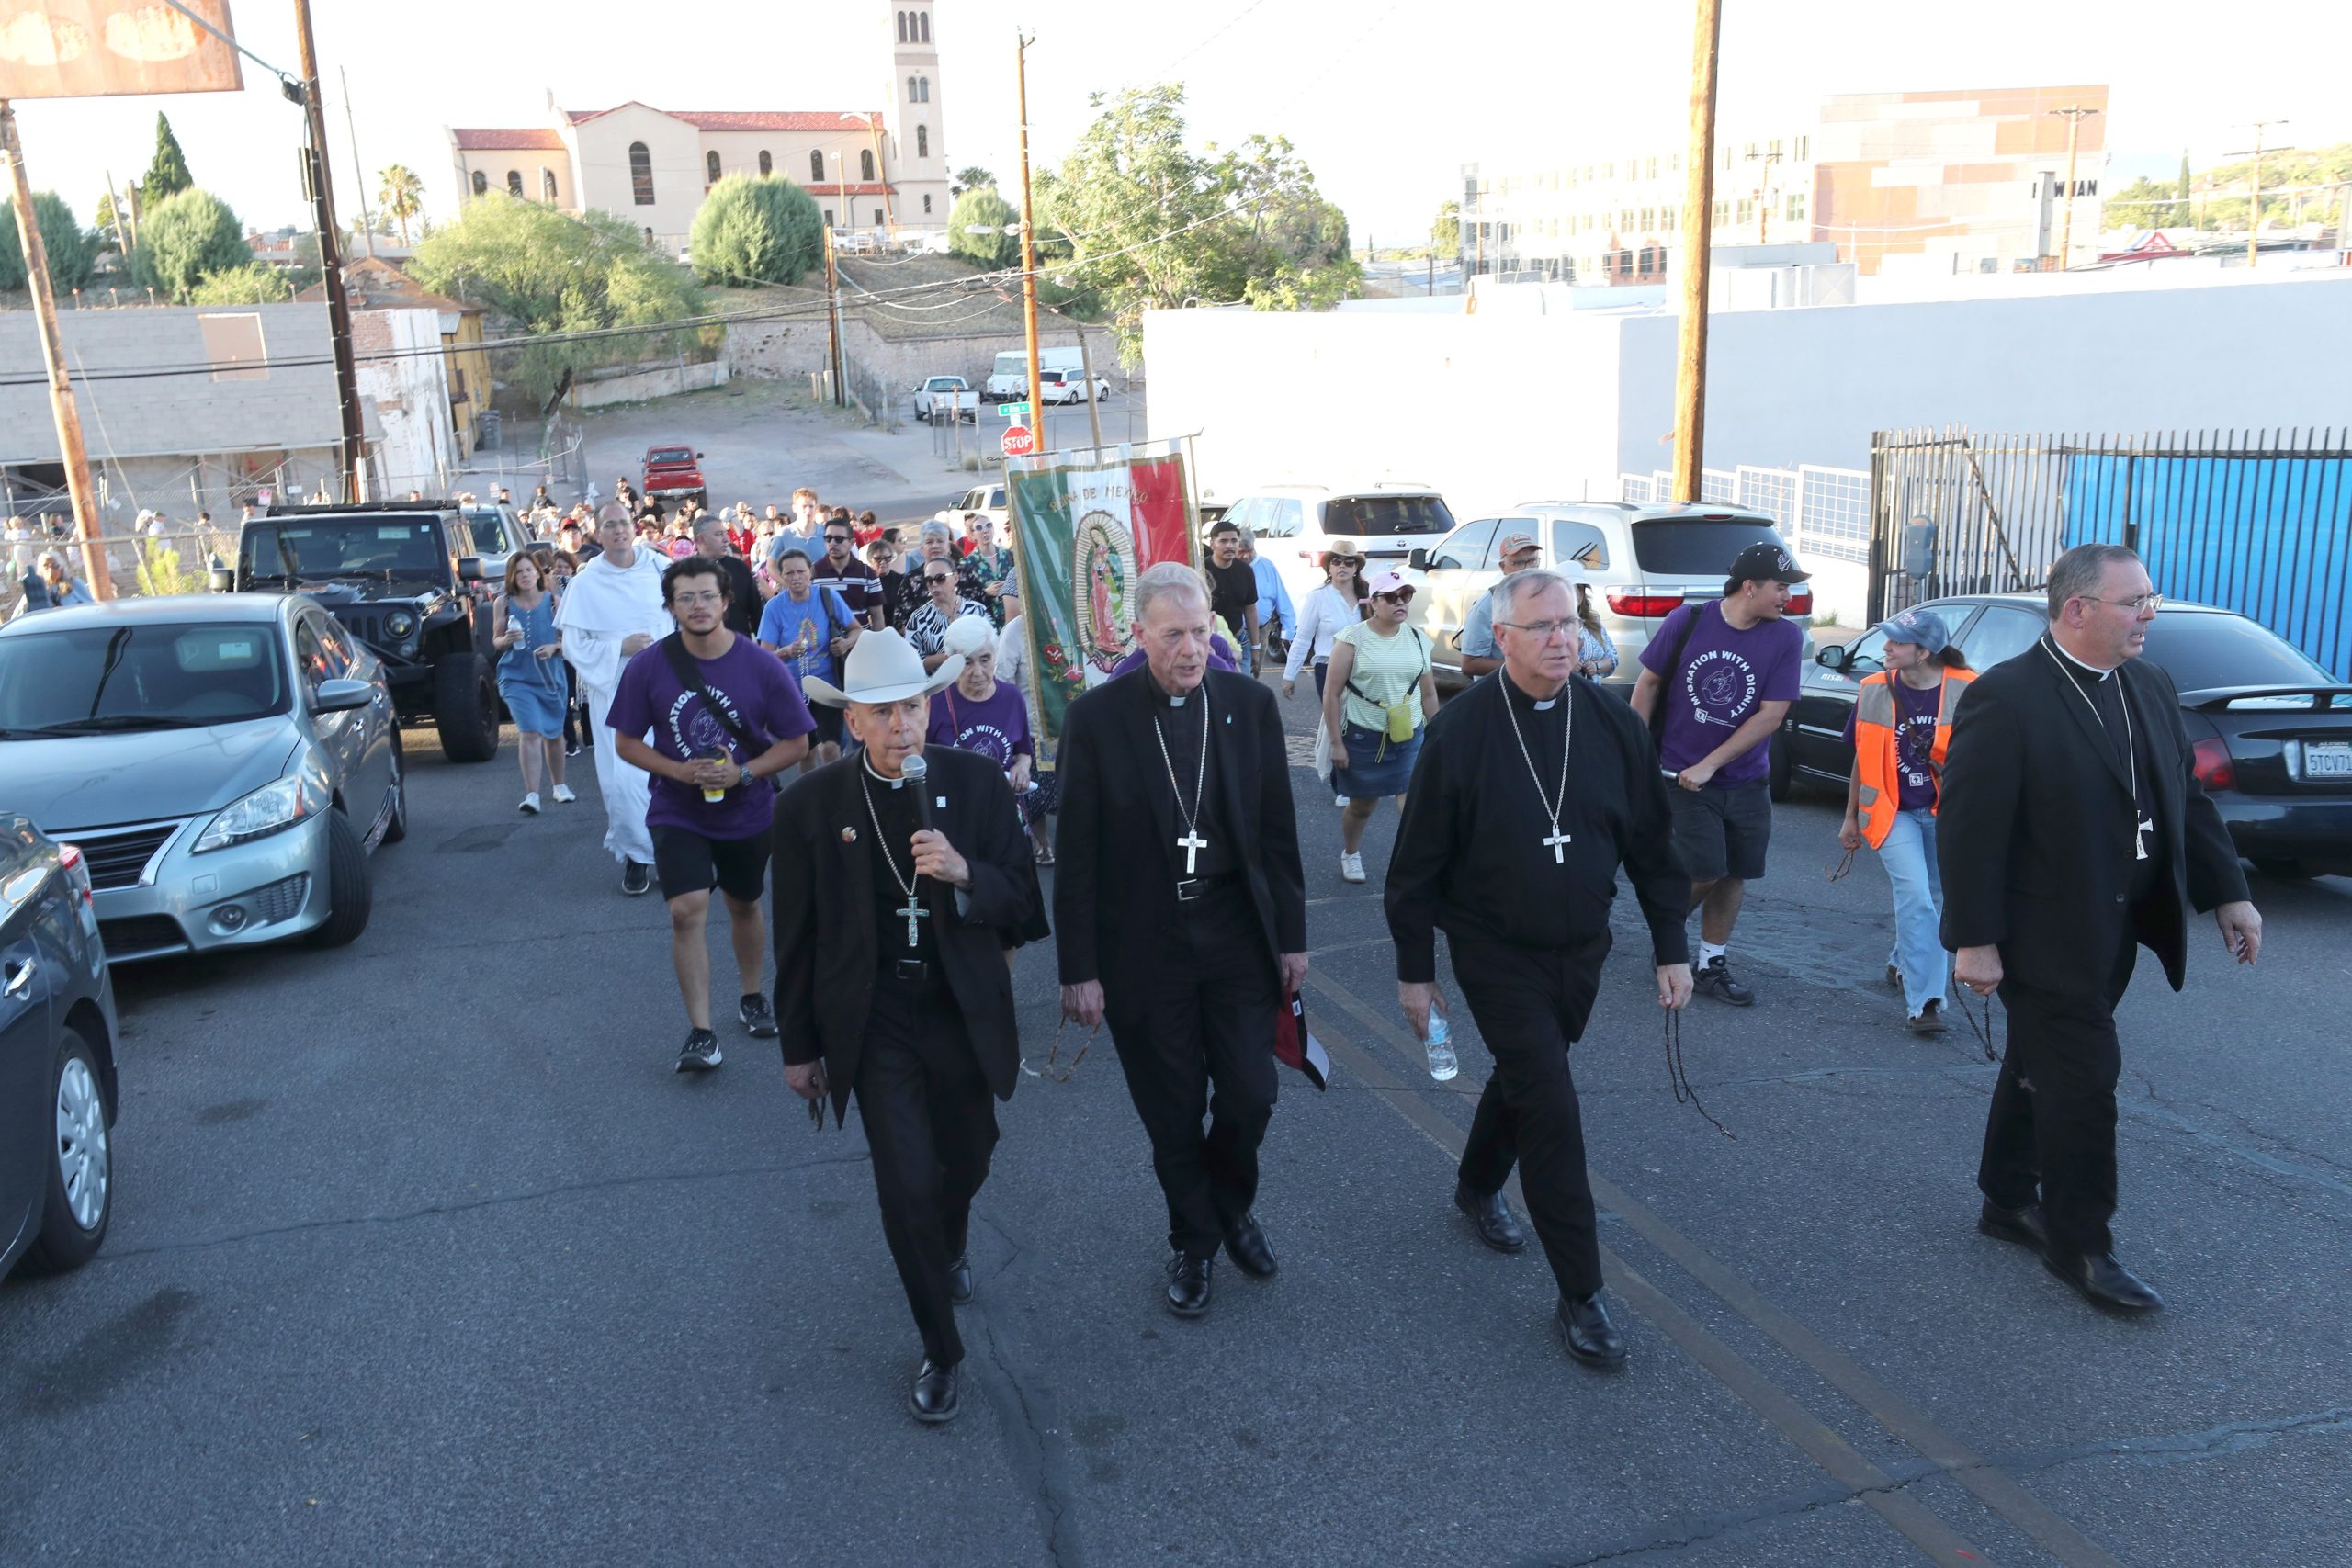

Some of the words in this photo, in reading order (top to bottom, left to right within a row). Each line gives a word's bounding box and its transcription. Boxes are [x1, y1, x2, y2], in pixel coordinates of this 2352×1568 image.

[1004, 435, 1032, 449] STOP
[1082, 487, 1097, 501] DE
[1722, 650, 1750, 672] WITH
[1686, 650, 1717, 706] MIGRATION
[1730, 673, 1756, 718] DIGNITY
[976, 724, 1002, 739] WITH
